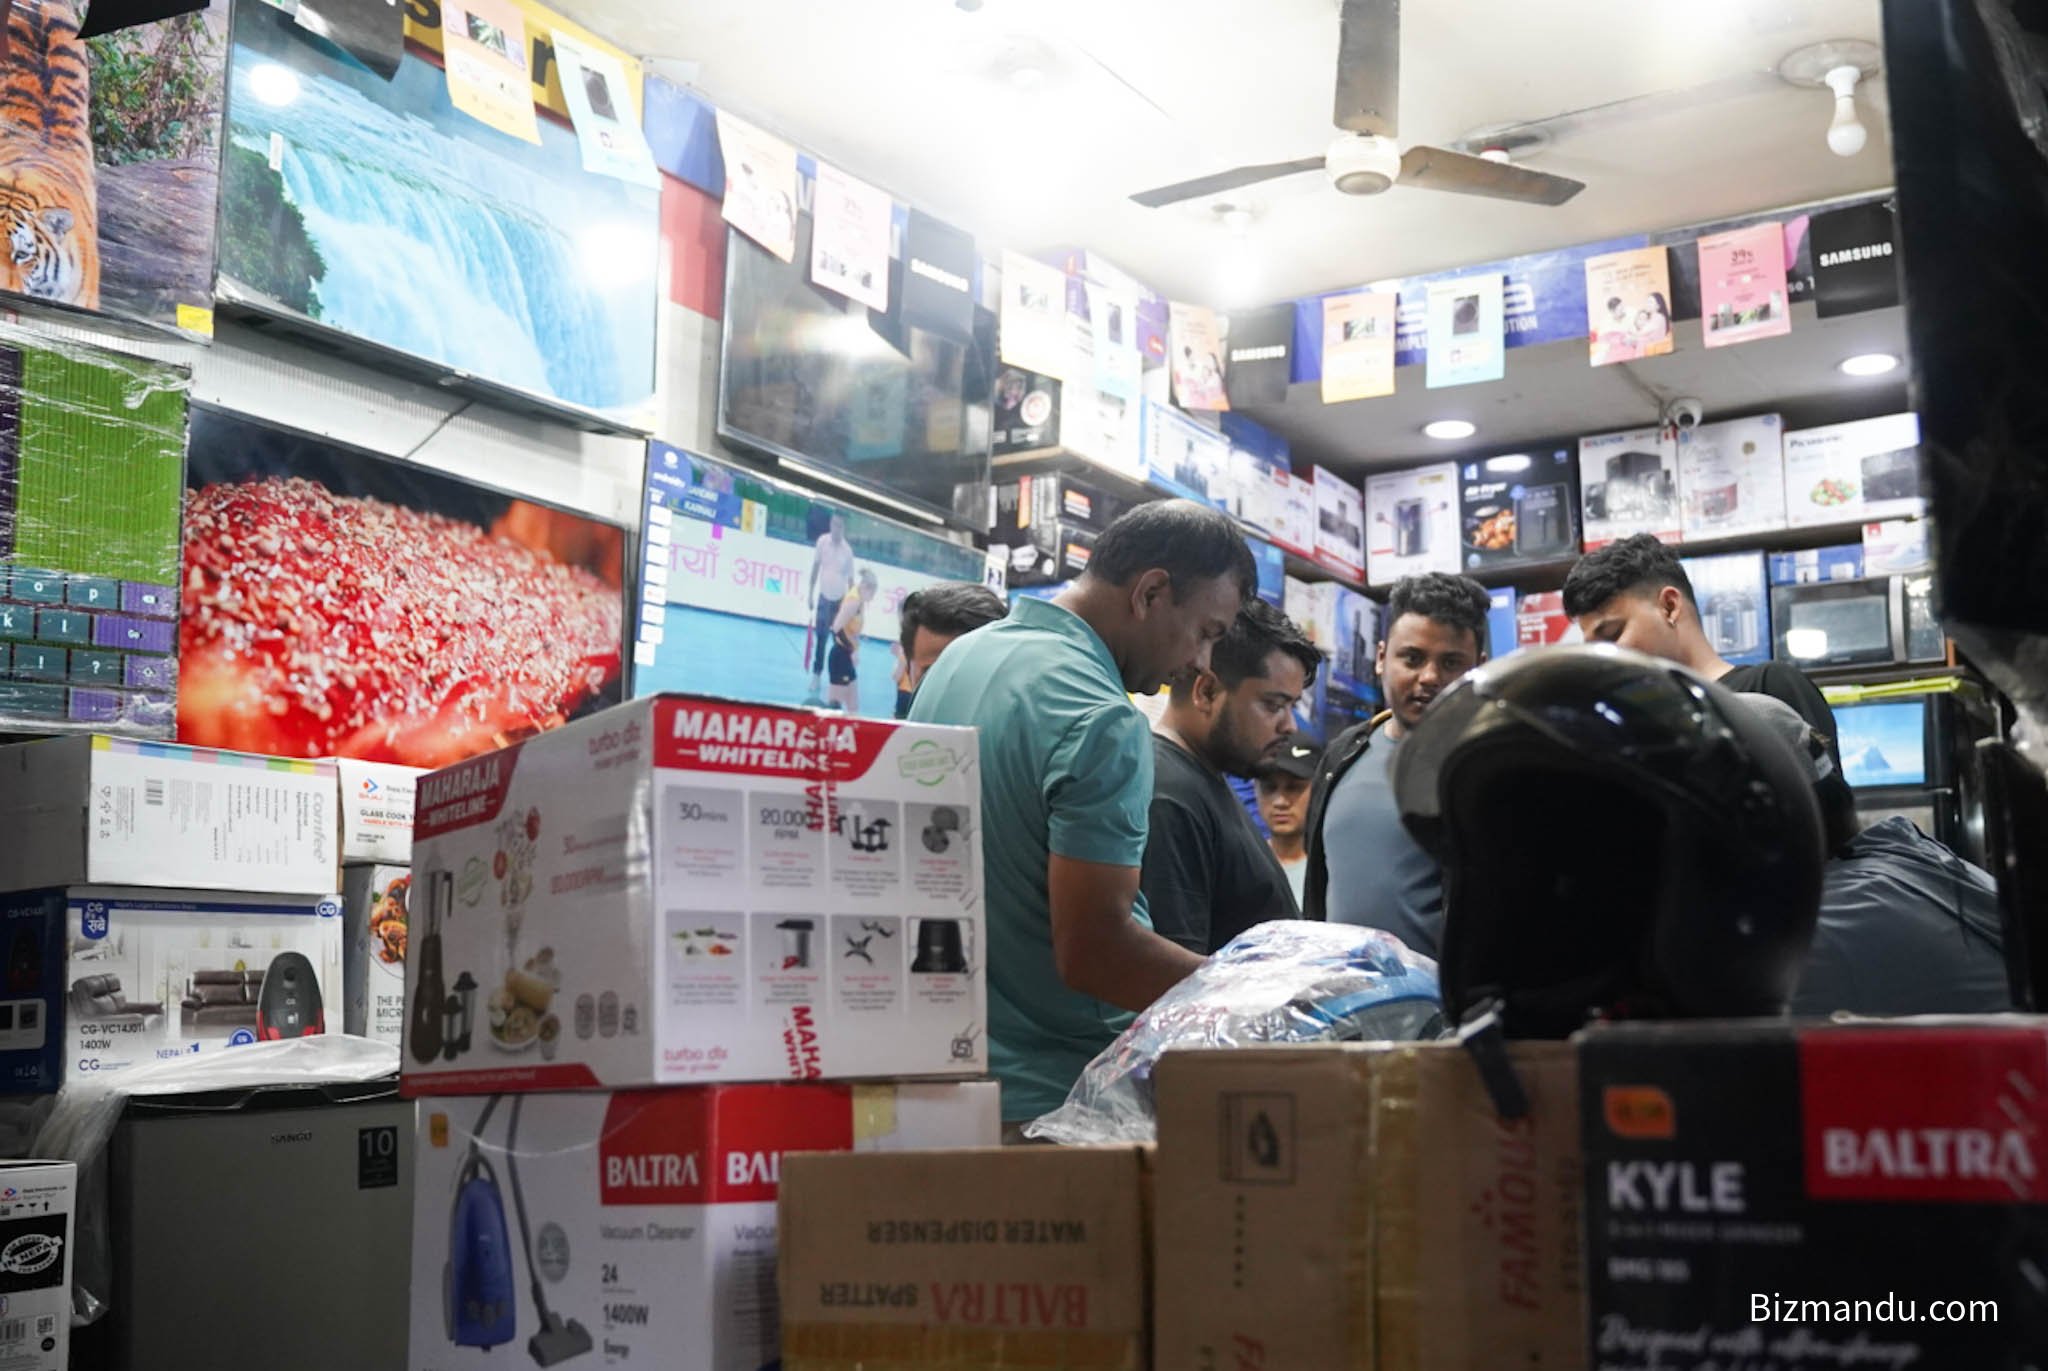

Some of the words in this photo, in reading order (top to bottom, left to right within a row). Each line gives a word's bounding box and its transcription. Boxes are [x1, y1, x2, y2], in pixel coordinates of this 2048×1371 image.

[1819, 242, 1893, 267] SAMSUNG
[910, 257, 969, 292] SAMSUNG
[1231, 344, 1286, 362] SAMSUNG
[89, 588, 99, 601] p
[421, 761, 500, 811] MAHARAJA
[320, 904, 336, 915] CG
[78, 1058, 100, 1072] CG
[362, 1130, 395, 1158] 10
[1823, 1127, 2036, 1181] BALTRA
[606, 1155, 699, 1188] BALTRA
[1607, 1161, 1745, 1212] KYLE
[1495, 1113, 1541, 1312] FAMOUS
[867, 1220, 998, 1246] DISPENSER
[1005, 1220, 1086, 1245] WATER
[19, 1239, 59, 1264] NEPAL
[602, 1264, 619, 1284] 24
[604, 1303, 649, 1326] 1400W
[820, 1283, 918, 1308] SPATTER
[931, 1283, 1088, 1330] BALTRA
